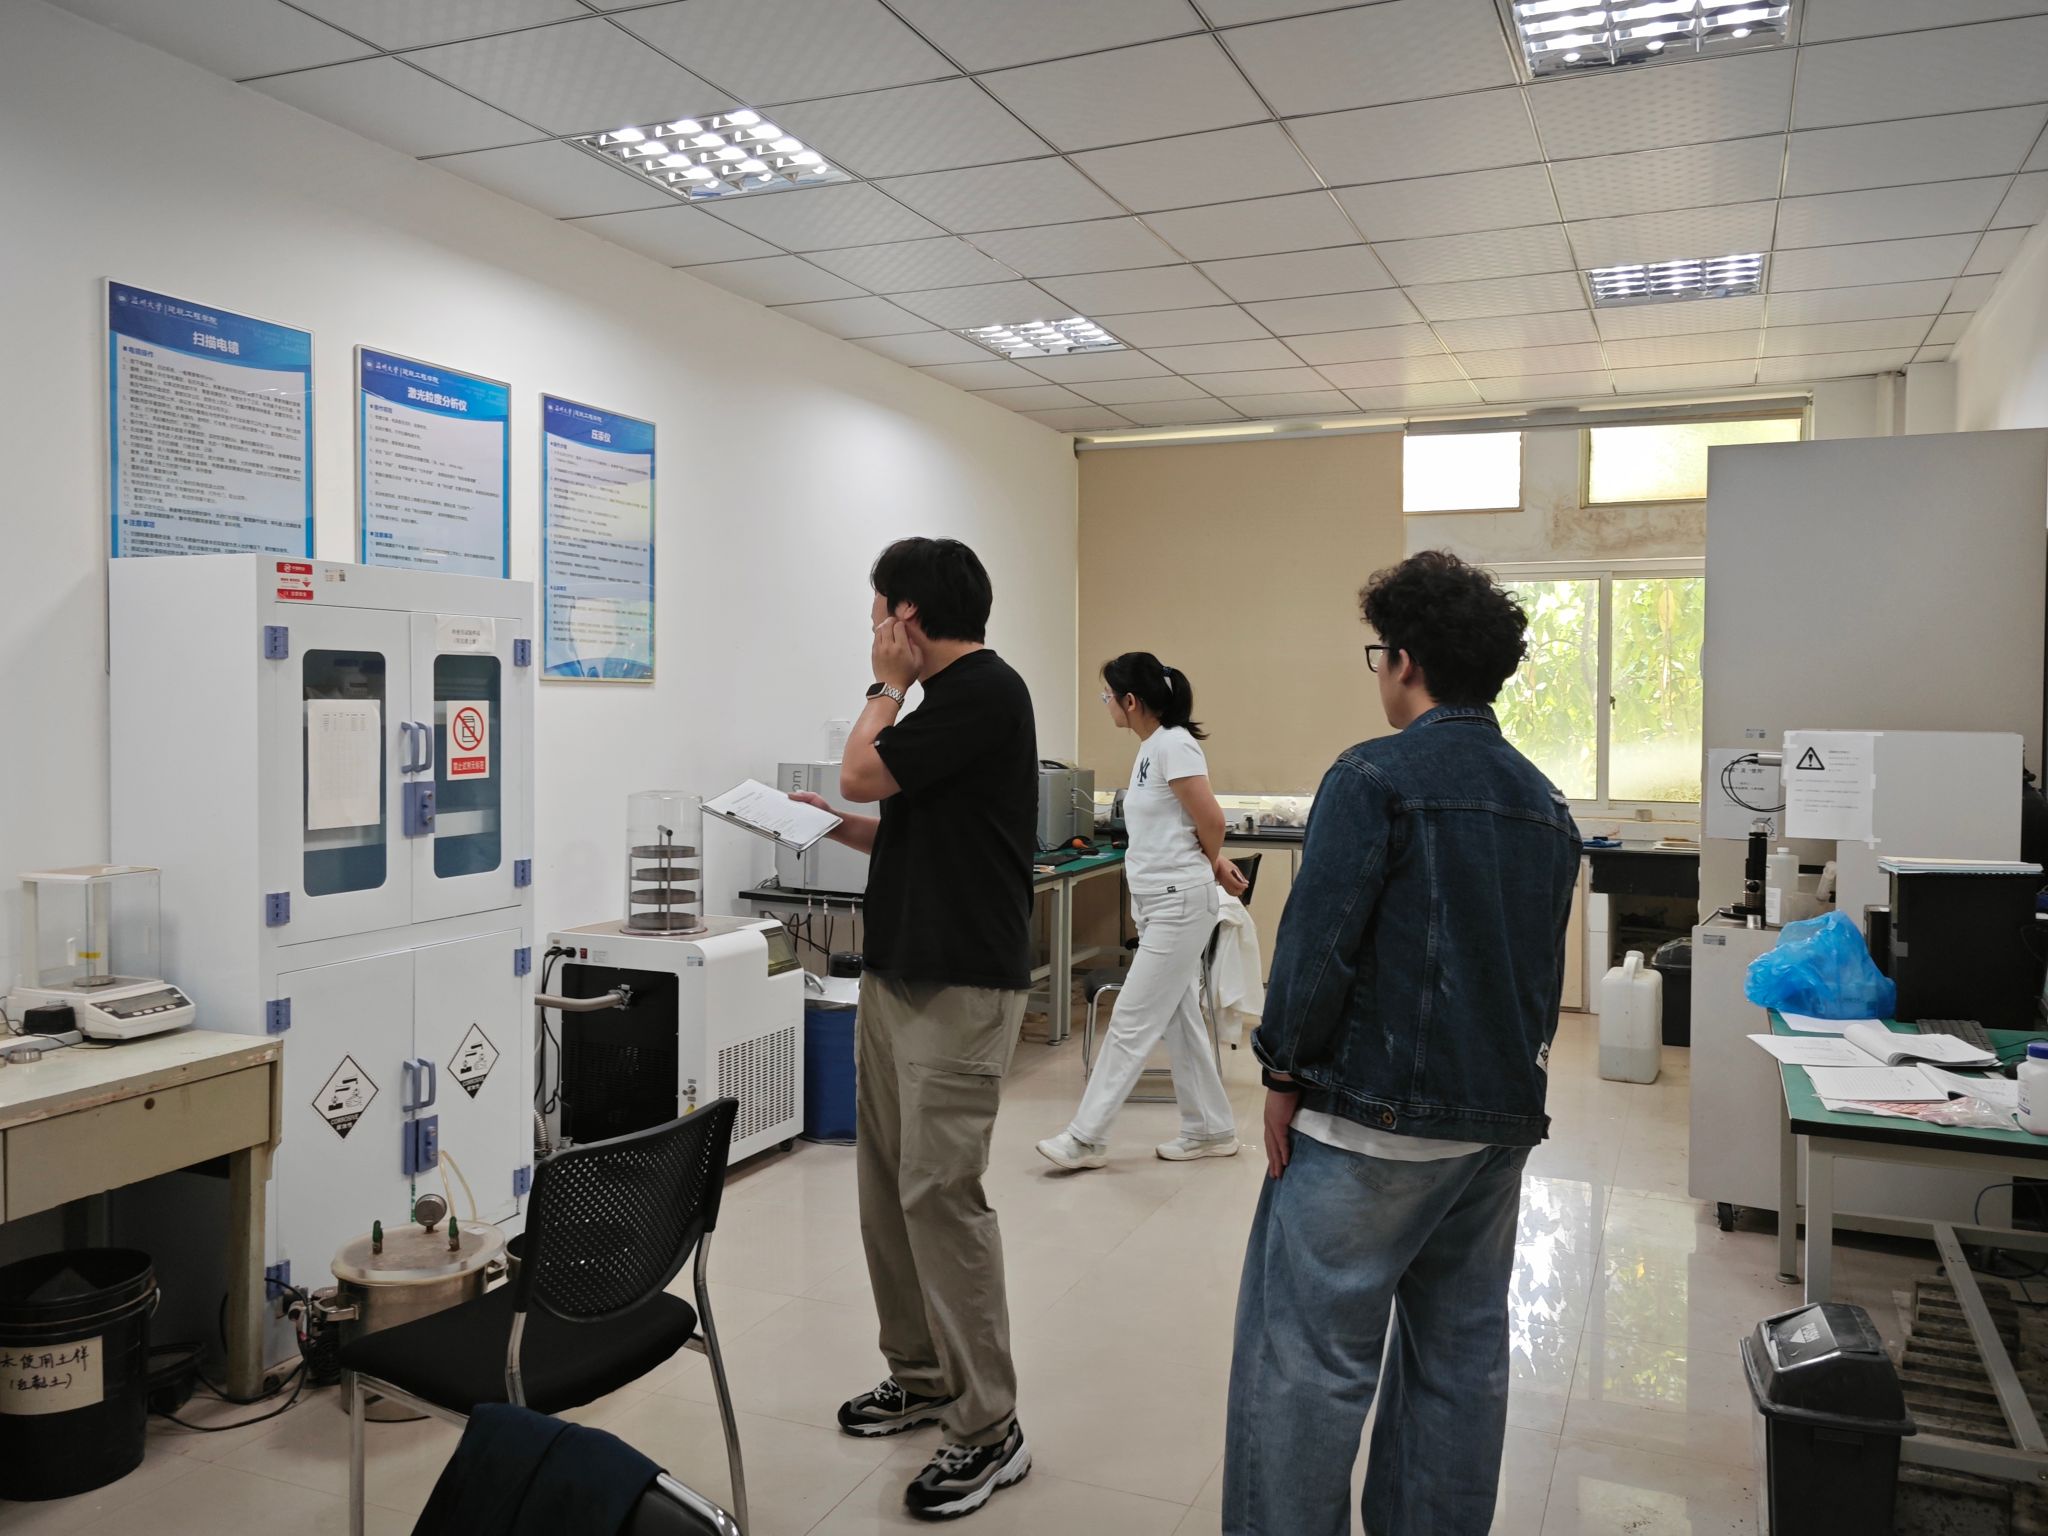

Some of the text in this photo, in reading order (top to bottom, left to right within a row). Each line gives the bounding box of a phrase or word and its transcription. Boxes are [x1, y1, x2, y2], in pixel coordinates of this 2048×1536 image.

[192, 331, 240, 355] 扫描电镜
[407, 386, 468, 412] 激光粒度分析仪
[330, 1113, 360, 1126] CORROSIVE
[1801, 1322, 1820, 1343] PUSH
[0, 1345, 89, 1371] 未使用土样
